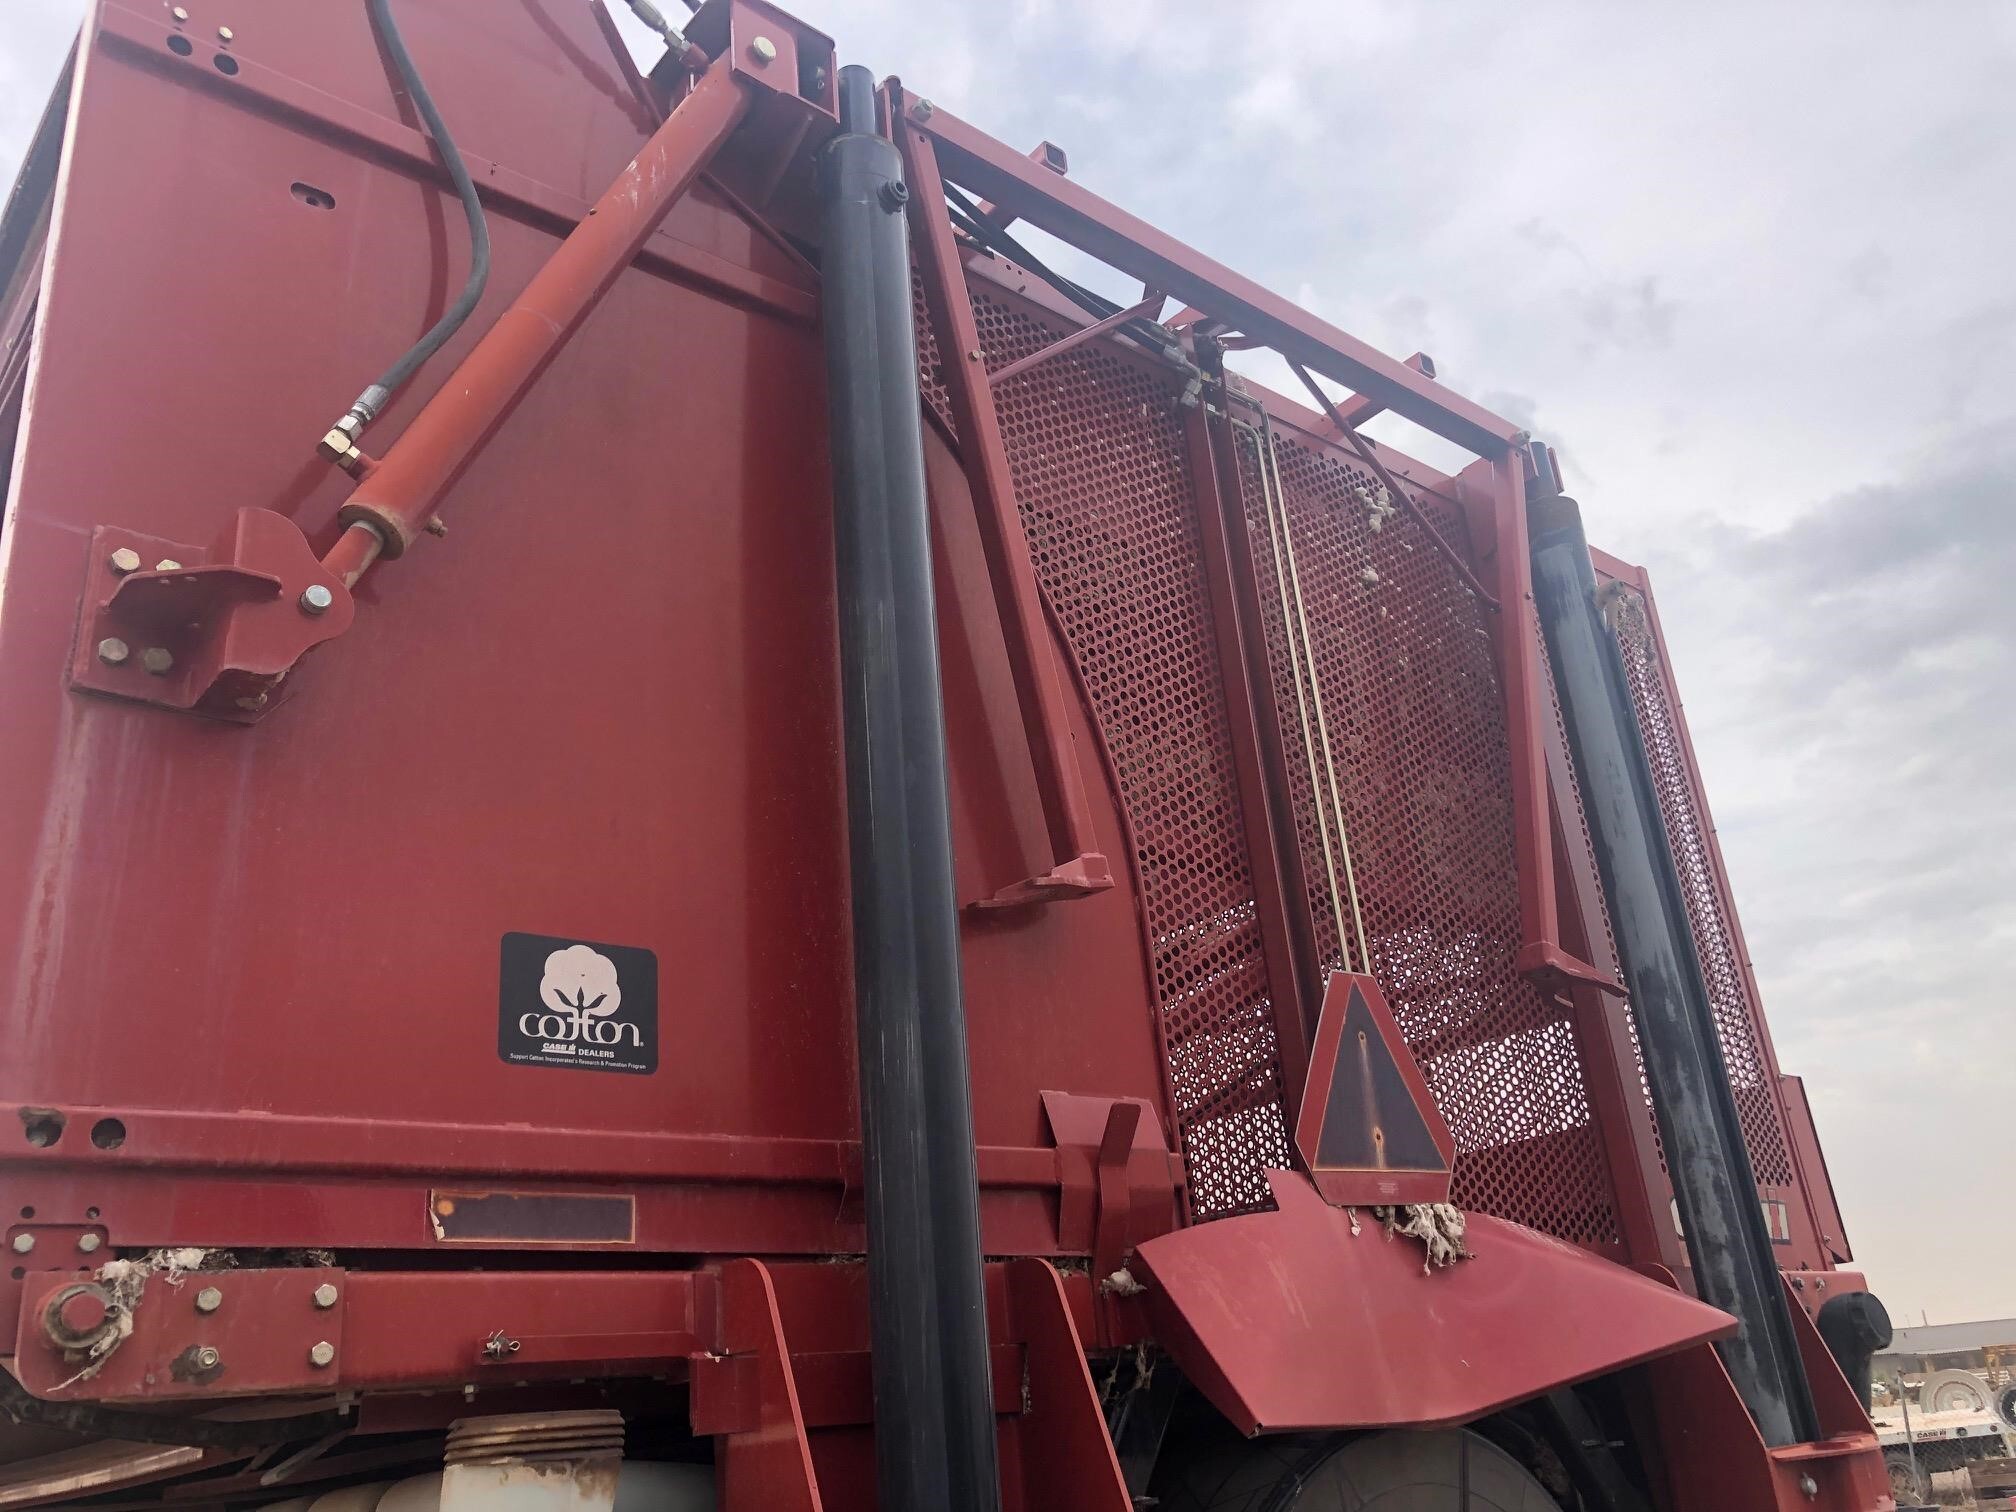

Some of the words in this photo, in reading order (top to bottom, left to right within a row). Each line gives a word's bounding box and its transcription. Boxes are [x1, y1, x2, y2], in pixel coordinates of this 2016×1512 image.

[542, 1042, 567, 1051] CASE
[578, 1048, 615, 1059] DEALERS
[510, 1052, 529, 1061] Support
[545, 1055, 579, 1064] Incorporated's
[578, 1058, 600, 1066] Research
[628, 1062, 647, 1070] Program
[1917, 1431, 1938, 1439] CASE
